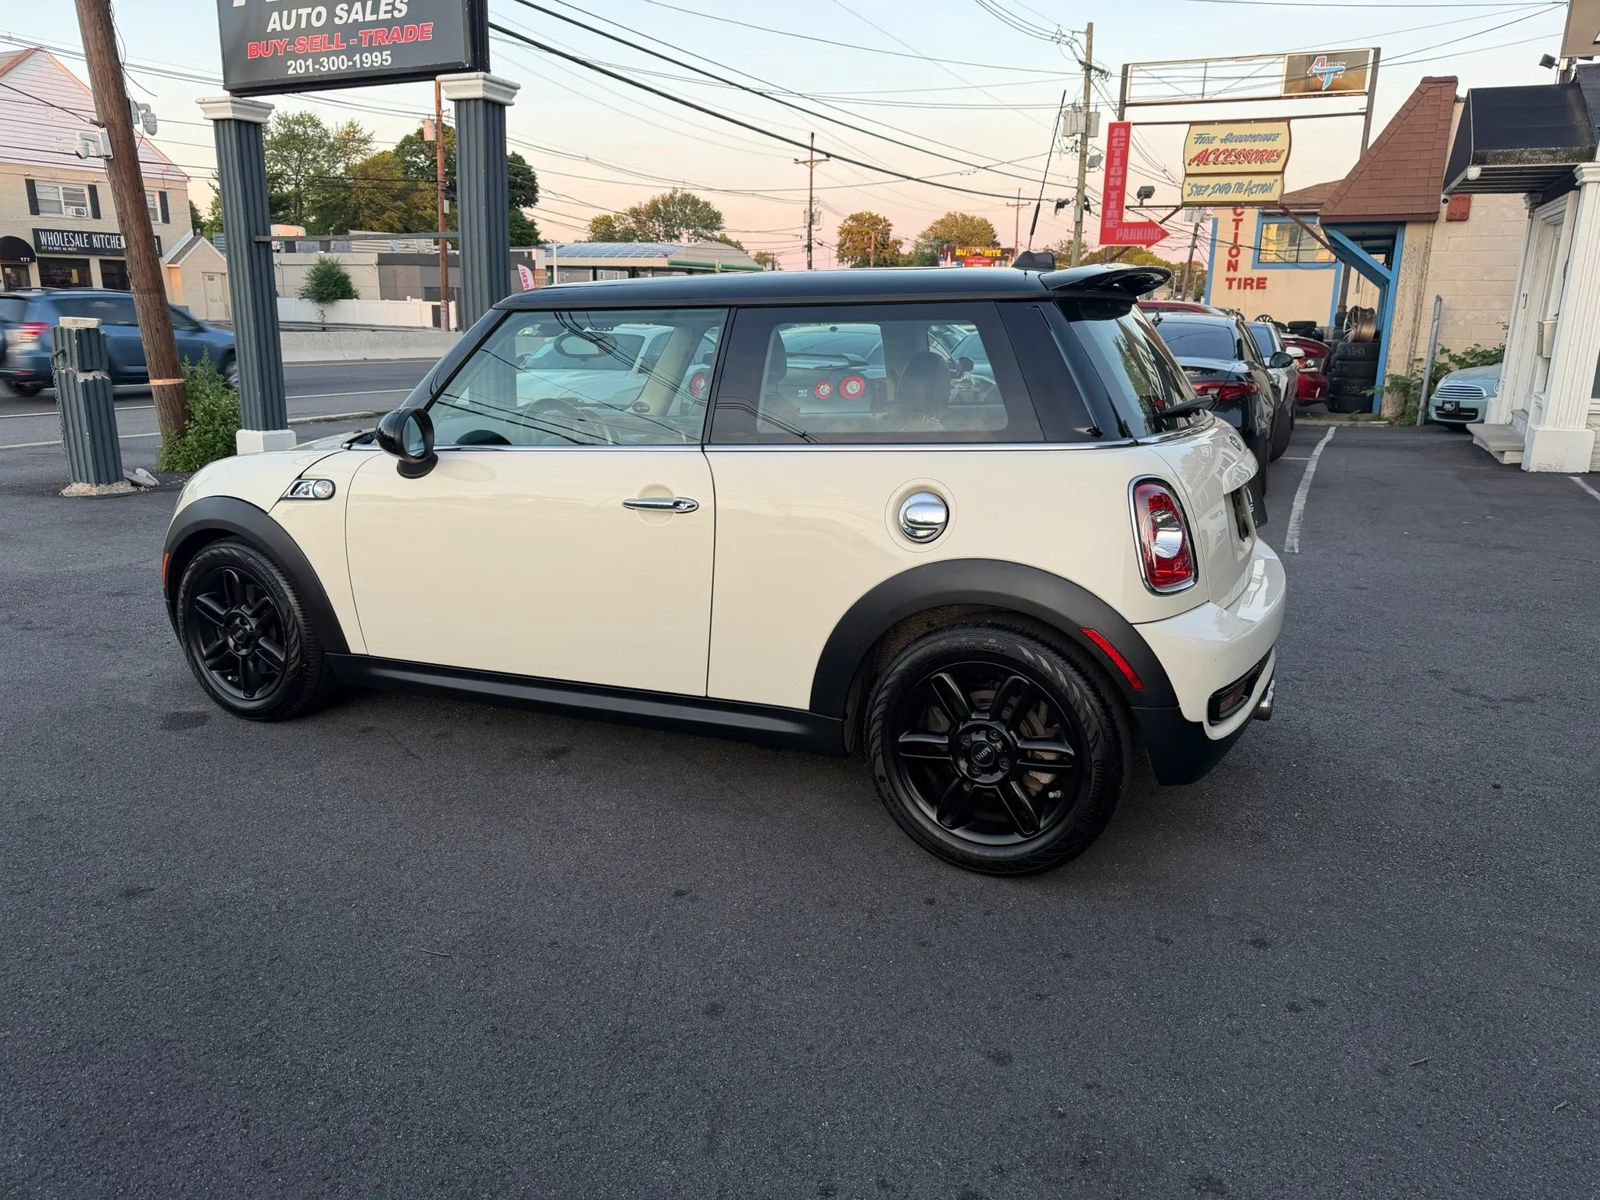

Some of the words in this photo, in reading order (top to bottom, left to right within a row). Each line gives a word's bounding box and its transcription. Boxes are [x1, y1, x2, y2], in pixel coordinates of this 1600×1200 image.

[266, 8, 327, 33] AUTO
[333, 0, 408, 25] SALES
[287, 50, 392, 75] 201-300-1995
[1108, 127, 1126, 187] ACTION
[1187, 147, 1285, 166] ACCESSORIES
[1105, 190, 1121, 229] TIRE
[38, 230, 90, 248] WHOLESALE
[1115, 227, 1161, 241] PARKING
[1227, 207, 1245, 272] CTION
[1225, 277, 1268, 290] TIRE
